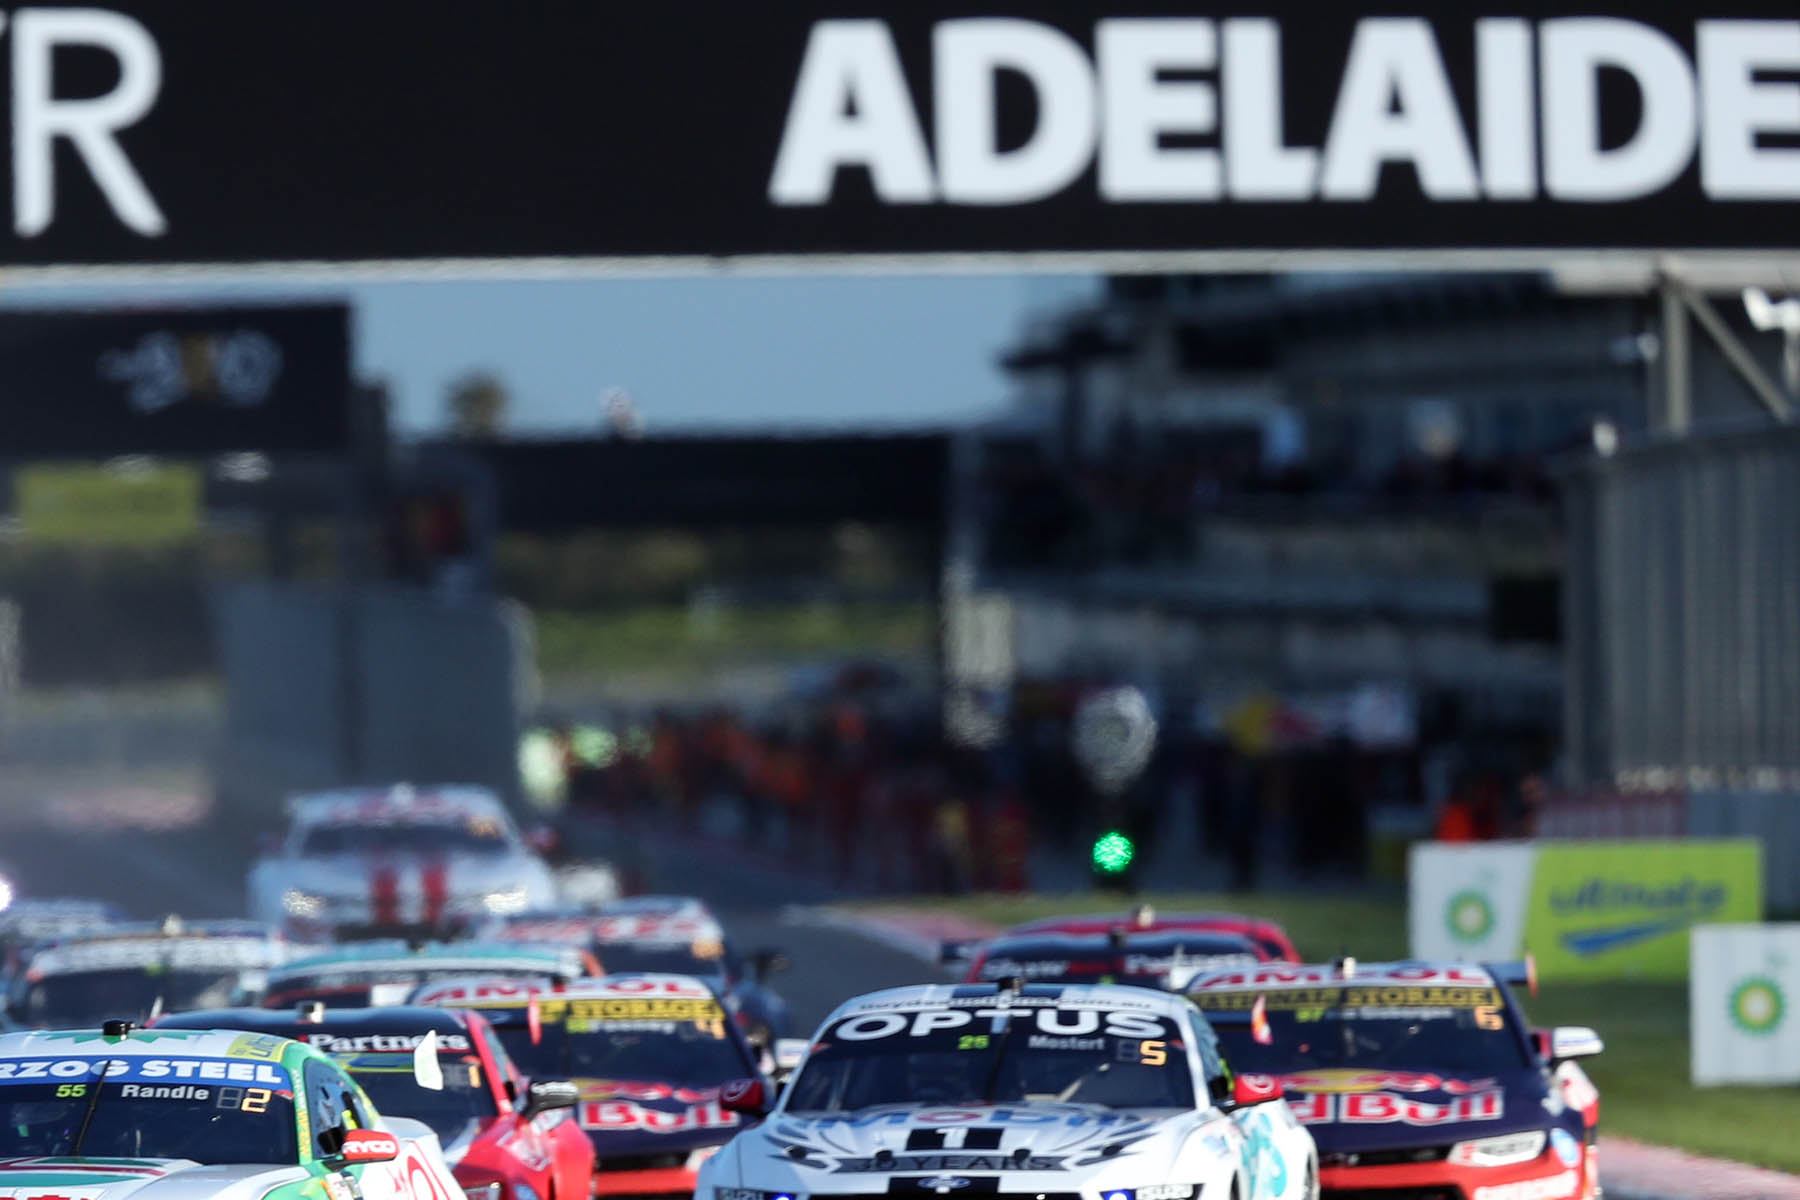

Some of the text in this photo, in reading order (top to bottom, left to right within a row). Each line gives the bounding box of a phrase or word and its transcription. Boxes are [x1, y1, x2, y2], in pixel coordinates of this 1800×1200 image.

[768, 17, 1800, 203] ADELAIDE
[836, 1009, 1166, 1040] OPTUS
[138, 1059, 282, 1084] STEEL
[56, 1084, 86, 1098] 55
[121, 1083, 210, 1101] Randle
[342, 1140, 396, 1154] RYCO
